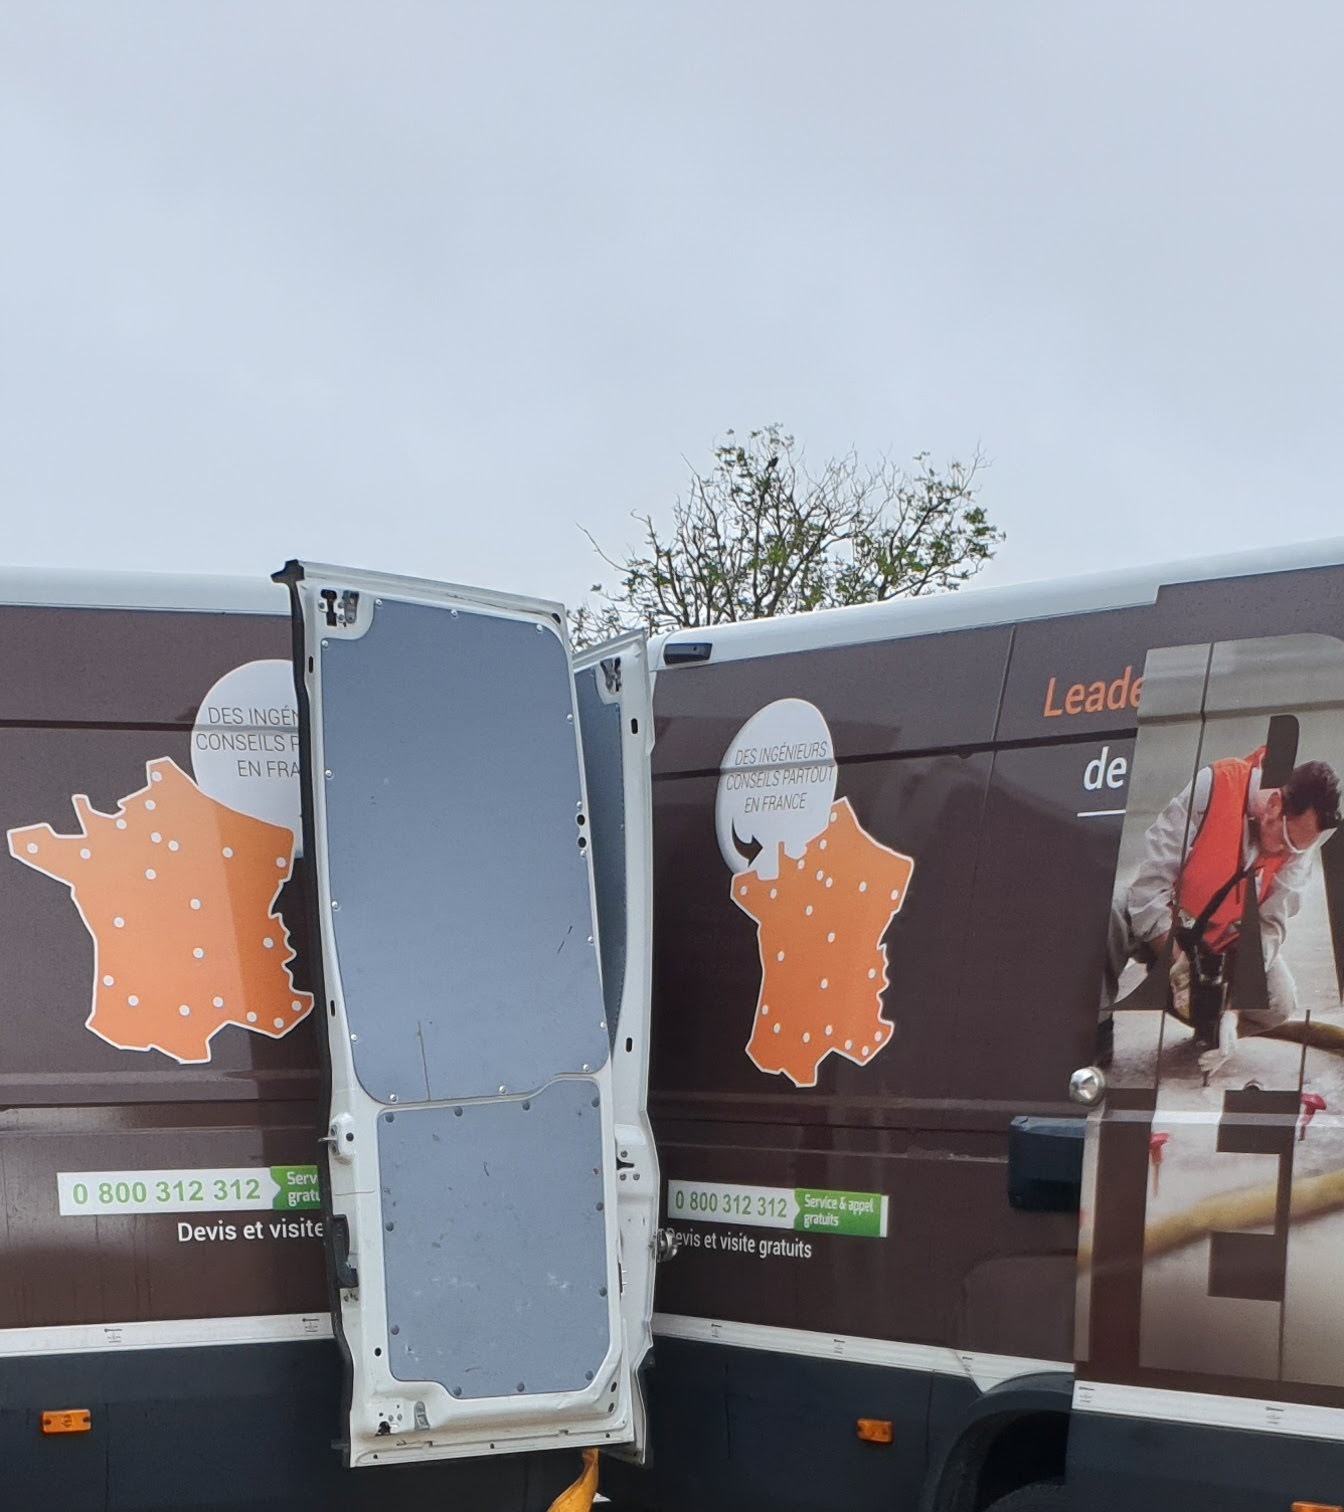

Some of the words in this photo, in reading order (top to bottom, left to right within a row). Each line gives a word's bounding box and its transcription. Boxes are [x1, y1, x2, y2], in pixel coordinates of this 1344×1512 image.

[1043, 665, 1145, 717] Leade
[208, 707, 244, 724] DES
[196, 734, 285, 752] CONSEILS
[735, 748, 757, 765] DES
[759, 741, 827, 763] INGÉNIEURS
[238, 760, 261, 777] EN
[726, 771, 780, 791] CONSEILS
[782, 765, 834, 785] PARTOUT
[1083, 745, 1127, 791] de
[744, 797, 760, 813] EN
[762, 793, 807, 811] FRANCE
[72, 1183, 88, 1204] 0
[98, 1182, 147, 1203] 800
[156, 1180, 204, 1202] 312
[214, 1178, 260, 1200] 312
[676, 1190, 684, 1209] 0
[690, 1192, 717, 1212] 800
[723, 1195, 751, 1215] 312
[757, 1197, 787, 1218] 312
[804, 1194, 837, 1210] Service
[839, 1198, 847, 1210] &
[849, 1199, 873, 1216] appel
[177, 1220, 237, 1242] Devis
[243, 1221, 264, 1239] et
[269, 1217, 324, 1239] visite
[804, 1213, 839, 1228] gratuits
[705, 1232, 717, 1249] et
[720, 1232, 755, 1253] visite
[759, 1239, 812, 1259] gratuits
